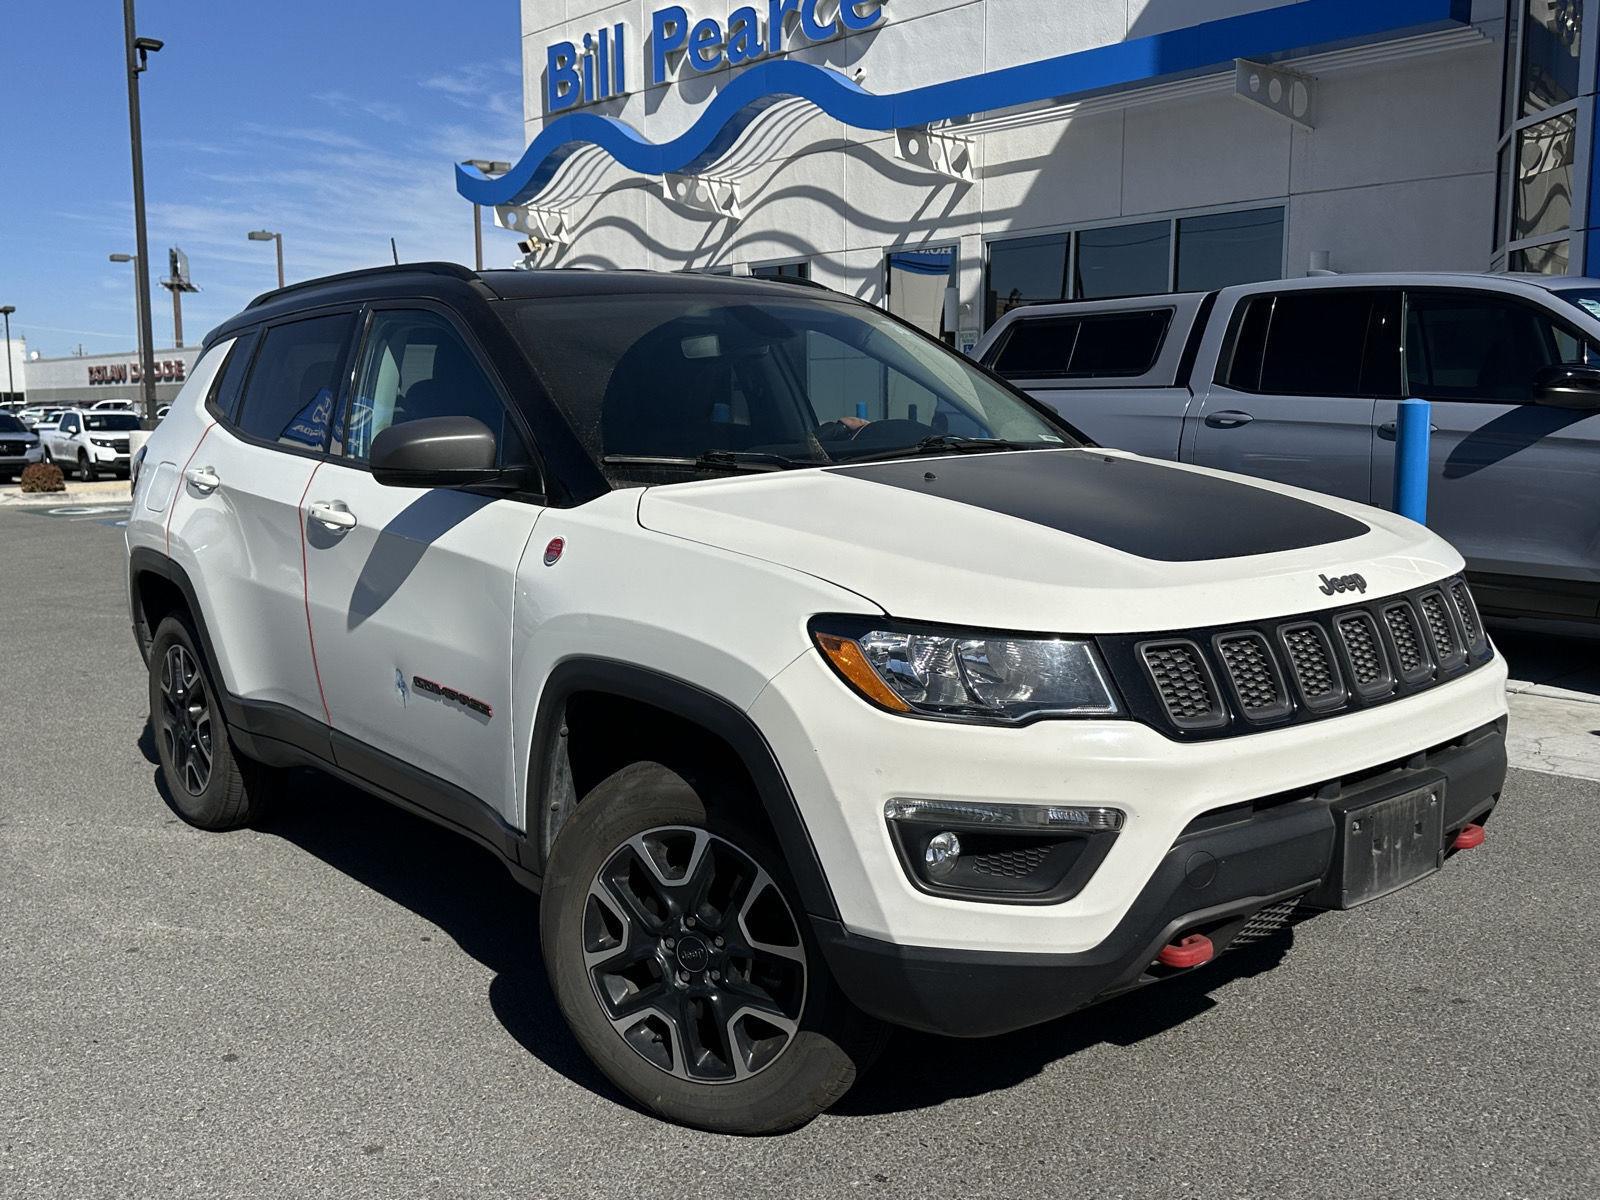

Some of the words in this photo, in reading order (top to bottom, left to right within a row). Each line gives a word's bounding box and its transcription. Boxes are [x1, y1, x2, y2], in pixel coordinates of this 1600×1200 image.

[547, 22, 626, 112] Bill
[652, 0, 882, 84] Pearce
[130, 360, 185, 383] DDGE
[1318, 572, 1367, 596] Jeep
